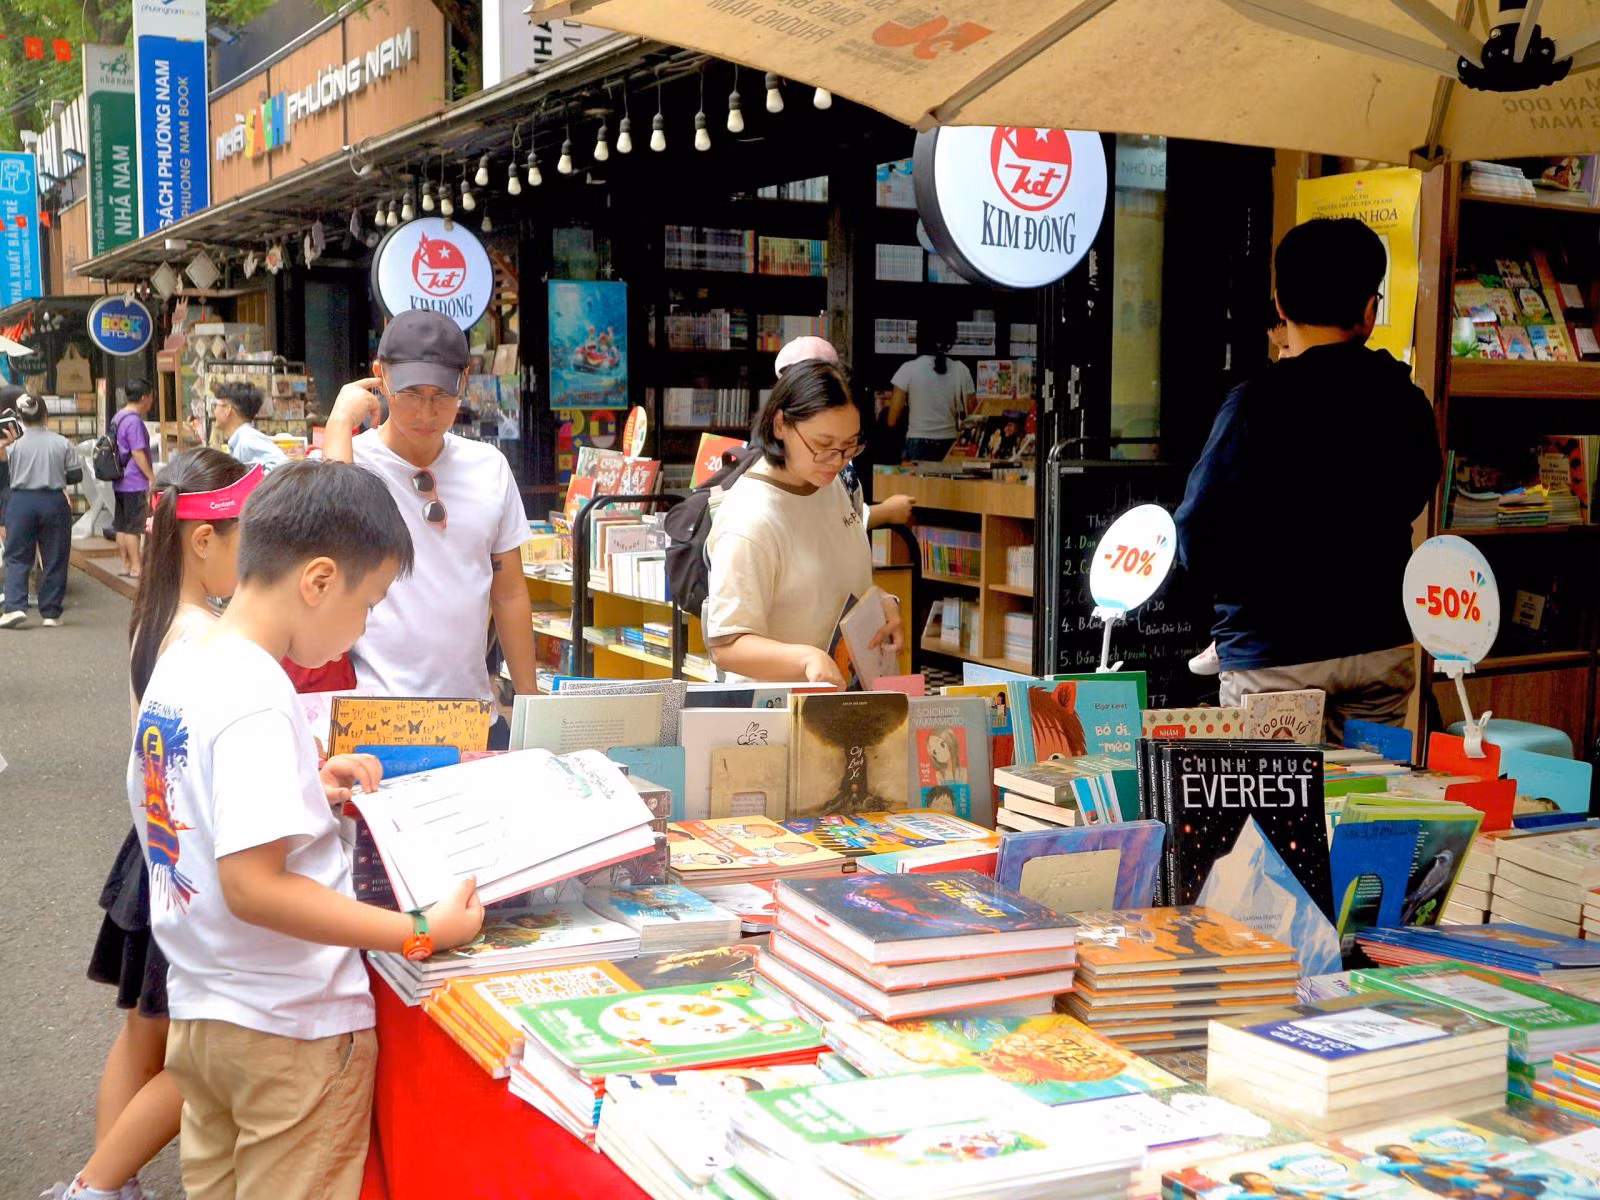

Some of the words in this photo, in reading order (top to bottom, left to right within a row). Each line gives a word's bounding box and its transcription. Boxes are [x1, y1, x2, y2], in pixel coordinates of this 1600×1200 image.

[365, 26, 413, 84] NAM
[155, 60, 170, 101] NAM
[177, 76, 190, 118] BOOK
[154, 102, 173, 178] PHƯƠNG
[179, 122, 190, 156] NAM
[112, 144, 130, 189] NAM
[108, 195, 132, 236] NHÃ
[154, 180, 174, 229] SÁCH
[981, 200, 1021, 250] KIM
[1023, 212, 1077, 255] ĐỒNG
[101, 316, 143, 333] BOOK
[1104, 544, 1156, 577] -70%
[1415, 584, 1481, 623] -50%
[1182, 757, 1246, 773] CHINH
[1182, 774, 1313, 808] EVEREST
